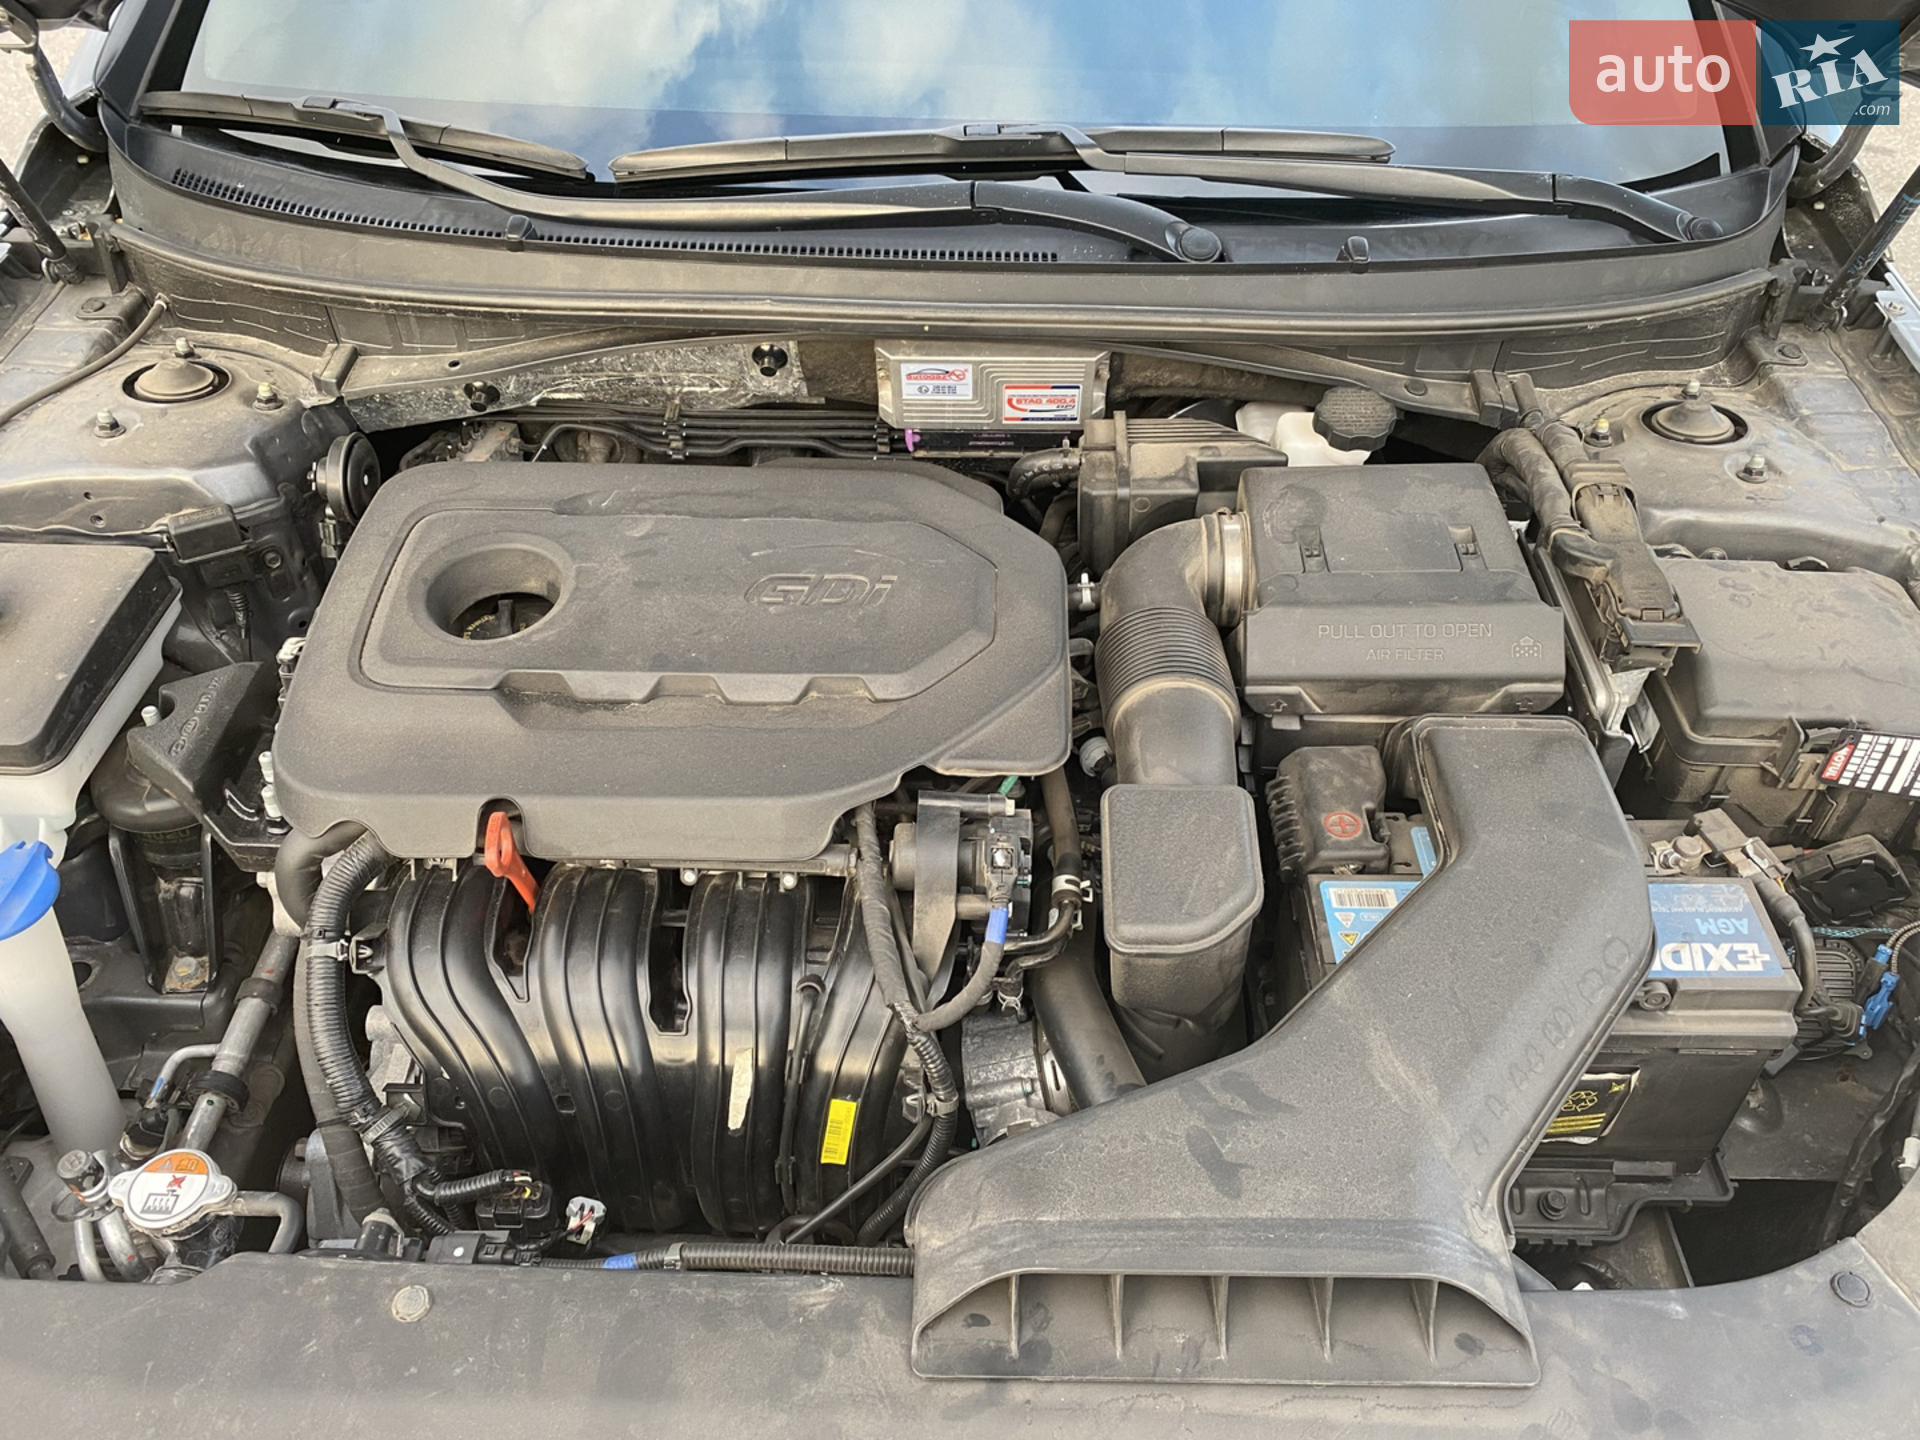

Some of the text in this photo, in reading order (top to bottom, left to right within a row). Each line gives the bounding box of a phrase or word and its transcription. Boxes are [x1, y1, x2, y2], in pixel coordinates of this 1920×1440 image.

[1317, 622, 1493, 640] PULL OUT TO OPEN
[1366, 648, 1445, 661] AIR FILTER
[1694, 918, 1749, 935] AGM
